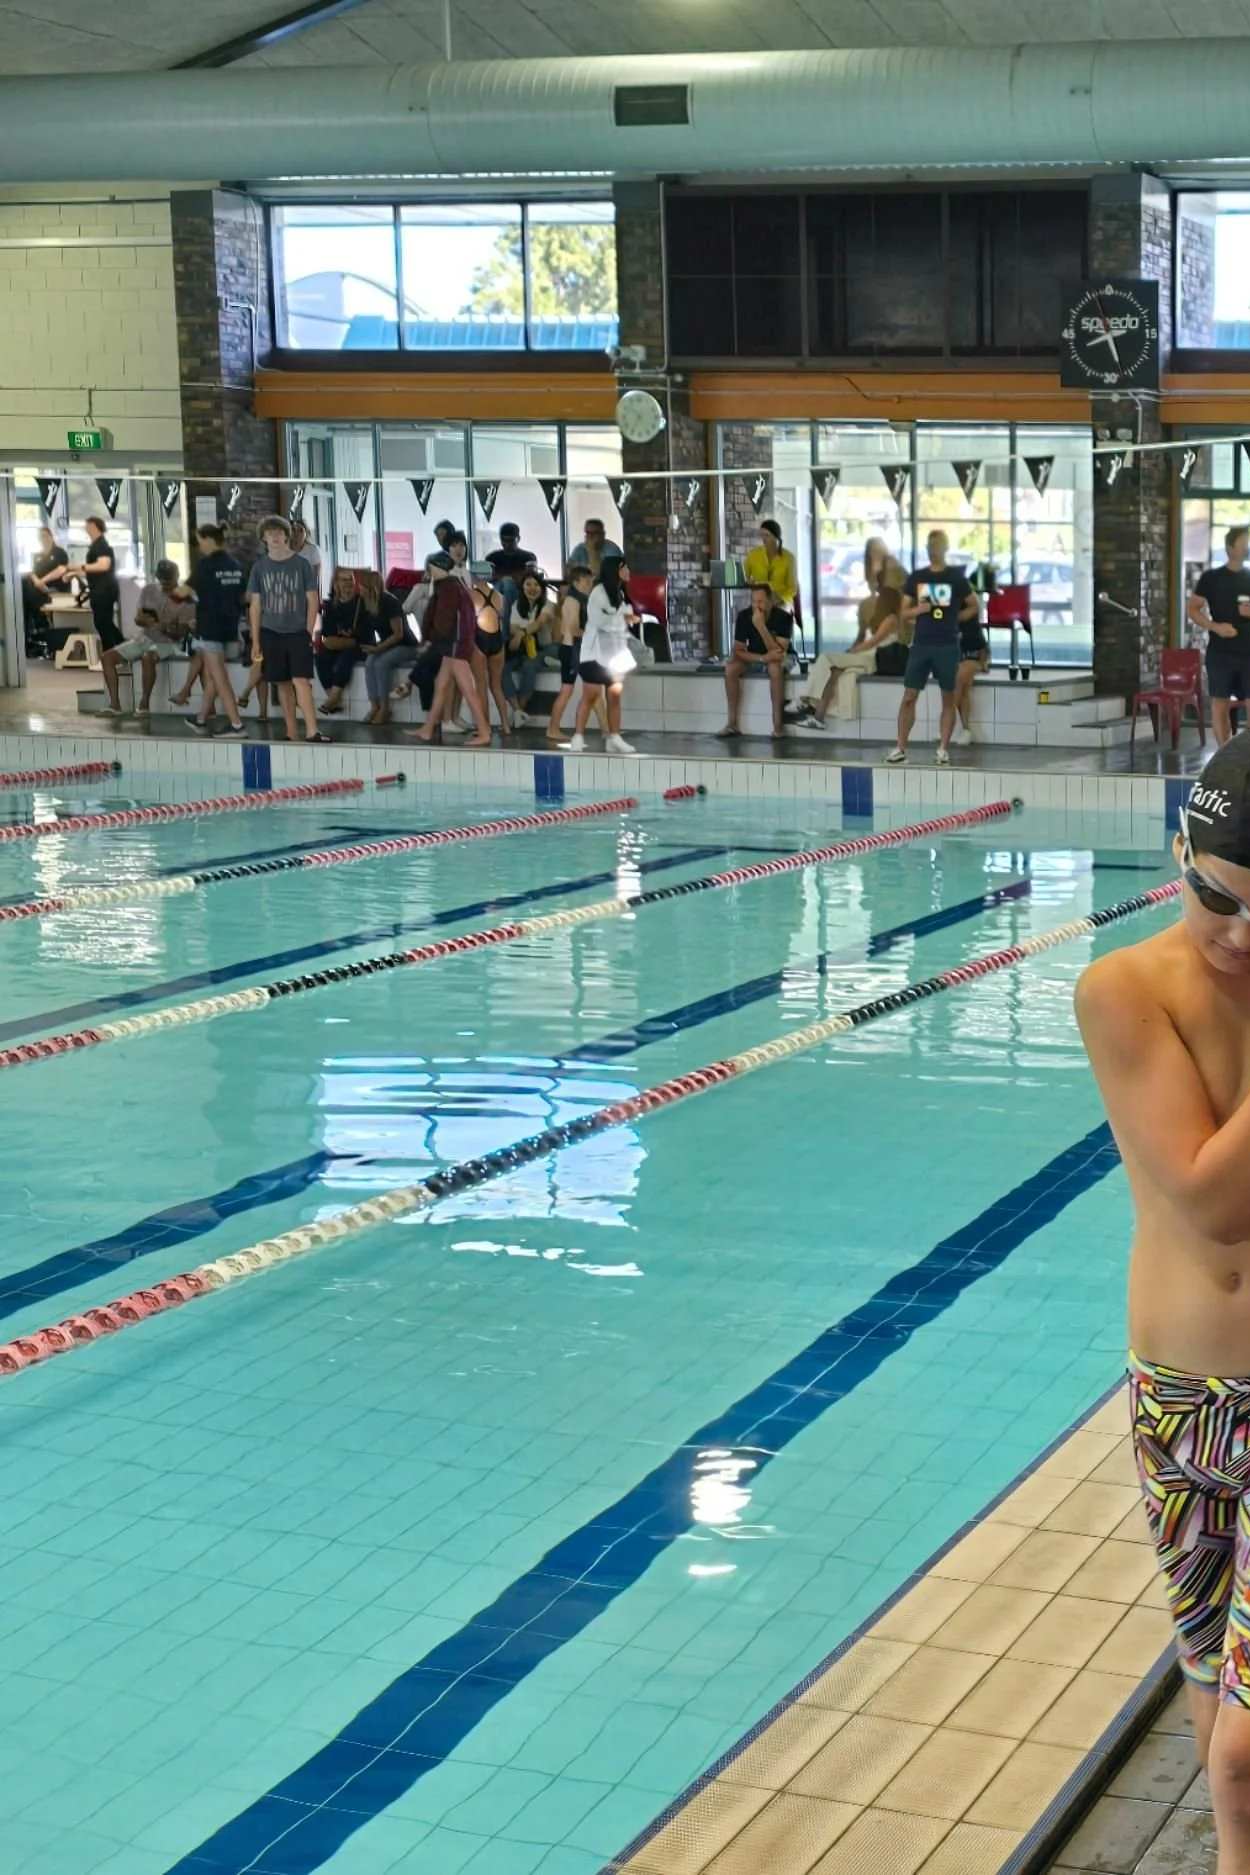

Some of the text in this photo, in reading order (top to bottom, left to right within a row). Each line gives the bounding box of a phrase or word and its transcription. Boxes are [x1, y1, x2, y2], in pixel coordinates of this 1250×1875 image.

[1061, 328, 1076, 339] 45
[1145, 328, 1158, 339] 15
[1103, 372, 1118, 384] 30
